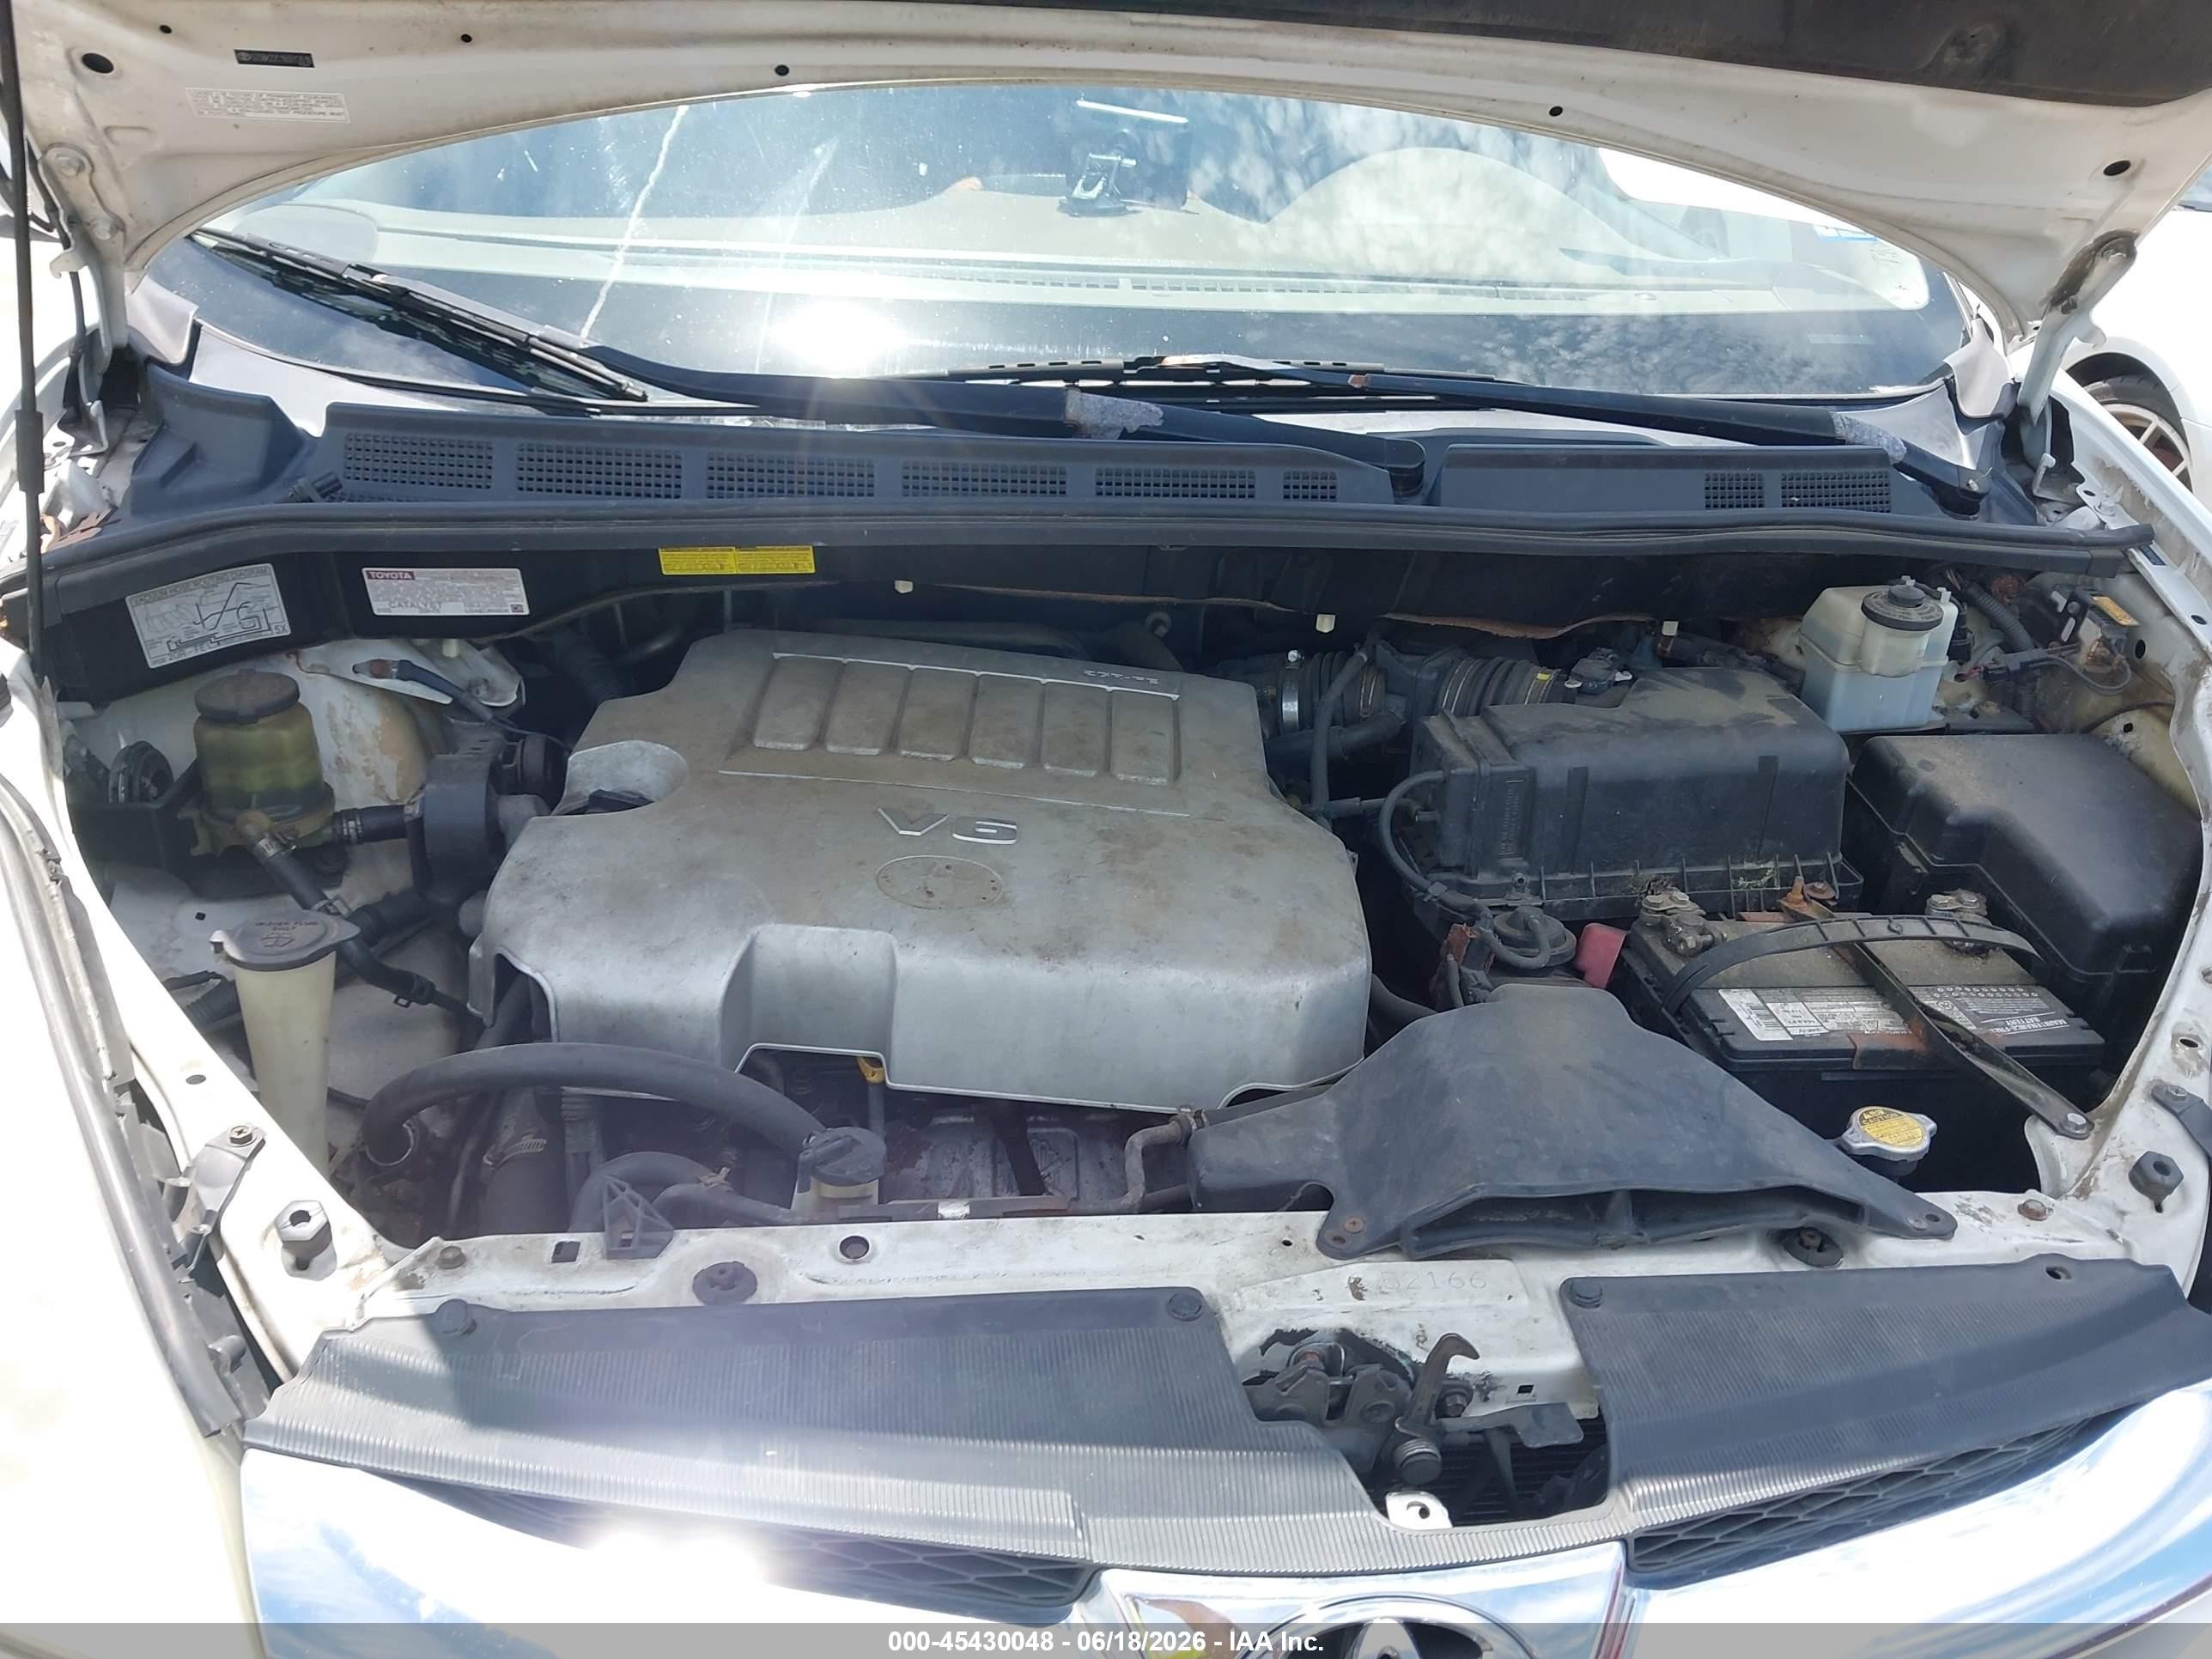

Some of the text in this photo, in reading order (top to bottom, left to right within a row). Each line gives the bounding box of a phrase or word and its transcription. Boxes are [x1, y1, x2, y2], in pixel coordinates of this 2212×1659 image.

[369, 571, 411, 580] TOYOTA
[877, 806, 1018, 845] V6
[2005, 1017, 2040, 1027] BATTERY
